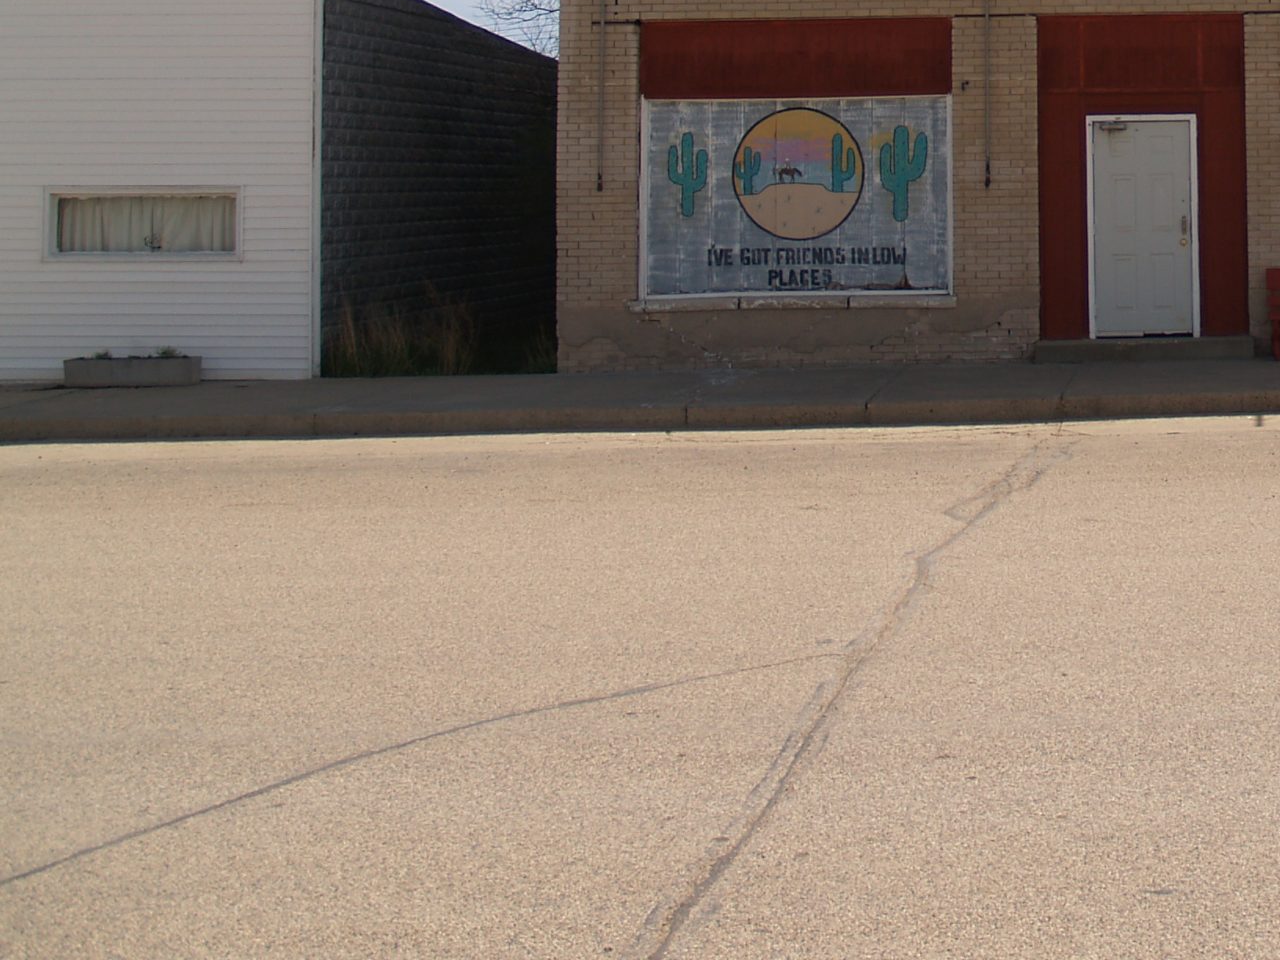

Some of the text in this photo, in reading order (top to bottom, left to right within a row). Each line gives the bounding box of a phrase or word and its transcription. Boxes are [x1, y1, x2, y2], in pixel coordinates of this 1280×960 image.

[740, 247, 771, 266] GOT
[776, 247, 846, 266] FRIENDS
[851, 247, 870, 265] IN
[872, 247, 906, 265] LOW
[768, 269, 833, 287] PLACES
